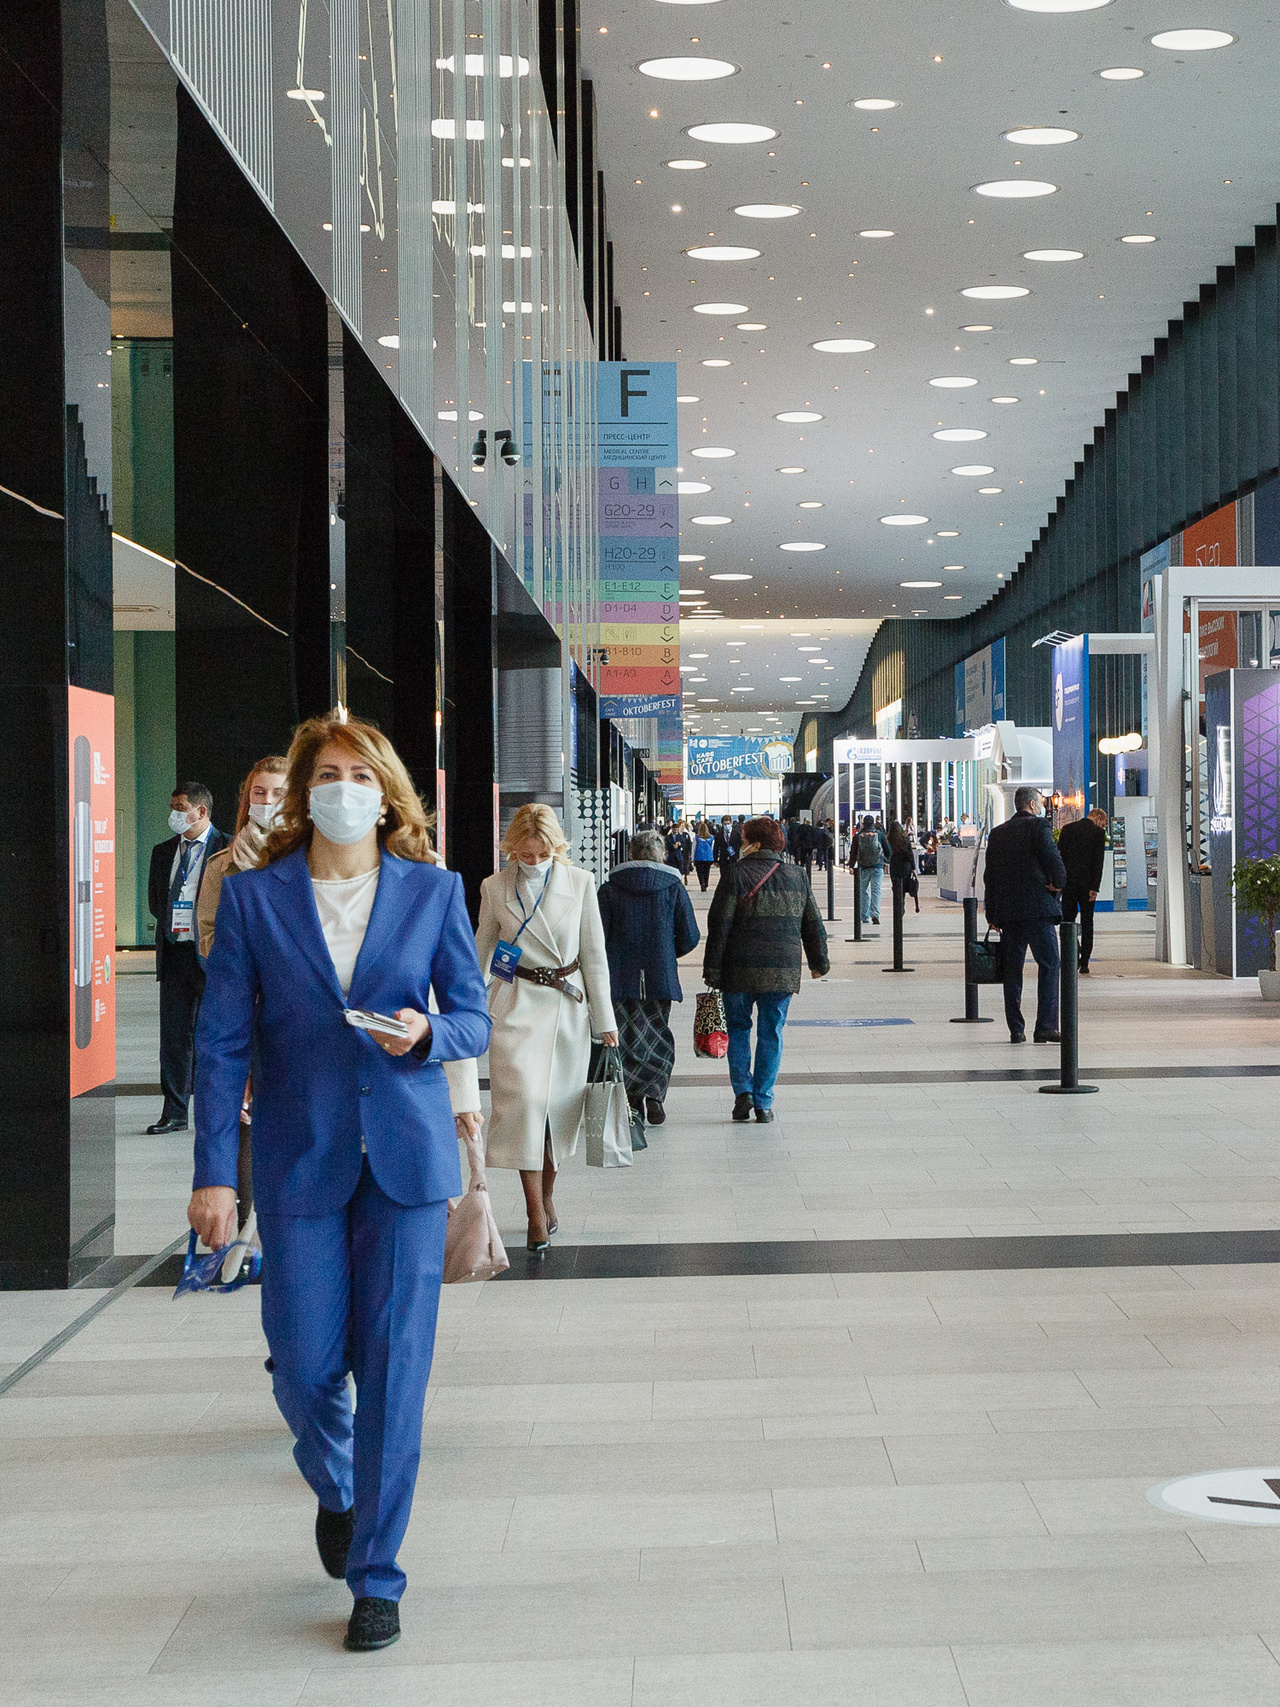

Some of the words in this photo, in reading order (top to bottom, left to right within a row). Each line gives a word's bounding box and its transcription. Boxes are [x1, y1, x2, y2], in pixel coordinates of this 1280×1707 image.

[620, 369, 650, 418] F
[603, 433, 650, 441] ПРЕСС-ЦЕНТР
[609, 476, 620, 490] G
[636, 476, 647, 490] H
[604, 503, 655, 517] G20-29
[604, 546, 656, 560] H20-29
[604, 581, 641, 590] E1-E12
[663, 583, 671, 593] E
[604, 603, 637, 612] D1-D4
[663, 604, 671, 615] D
[663, 626, 670, 636] C
[606, 647, 642, 656] B1-B10
[663, 648, 671, 658] B
[605, 669, 637, 678] A1-A9
[663, 669, 672, 679] A
[622, 698, 677, 717] OKTOBERFEST
[690, 752, 767, 776] OKTOBERFEST
